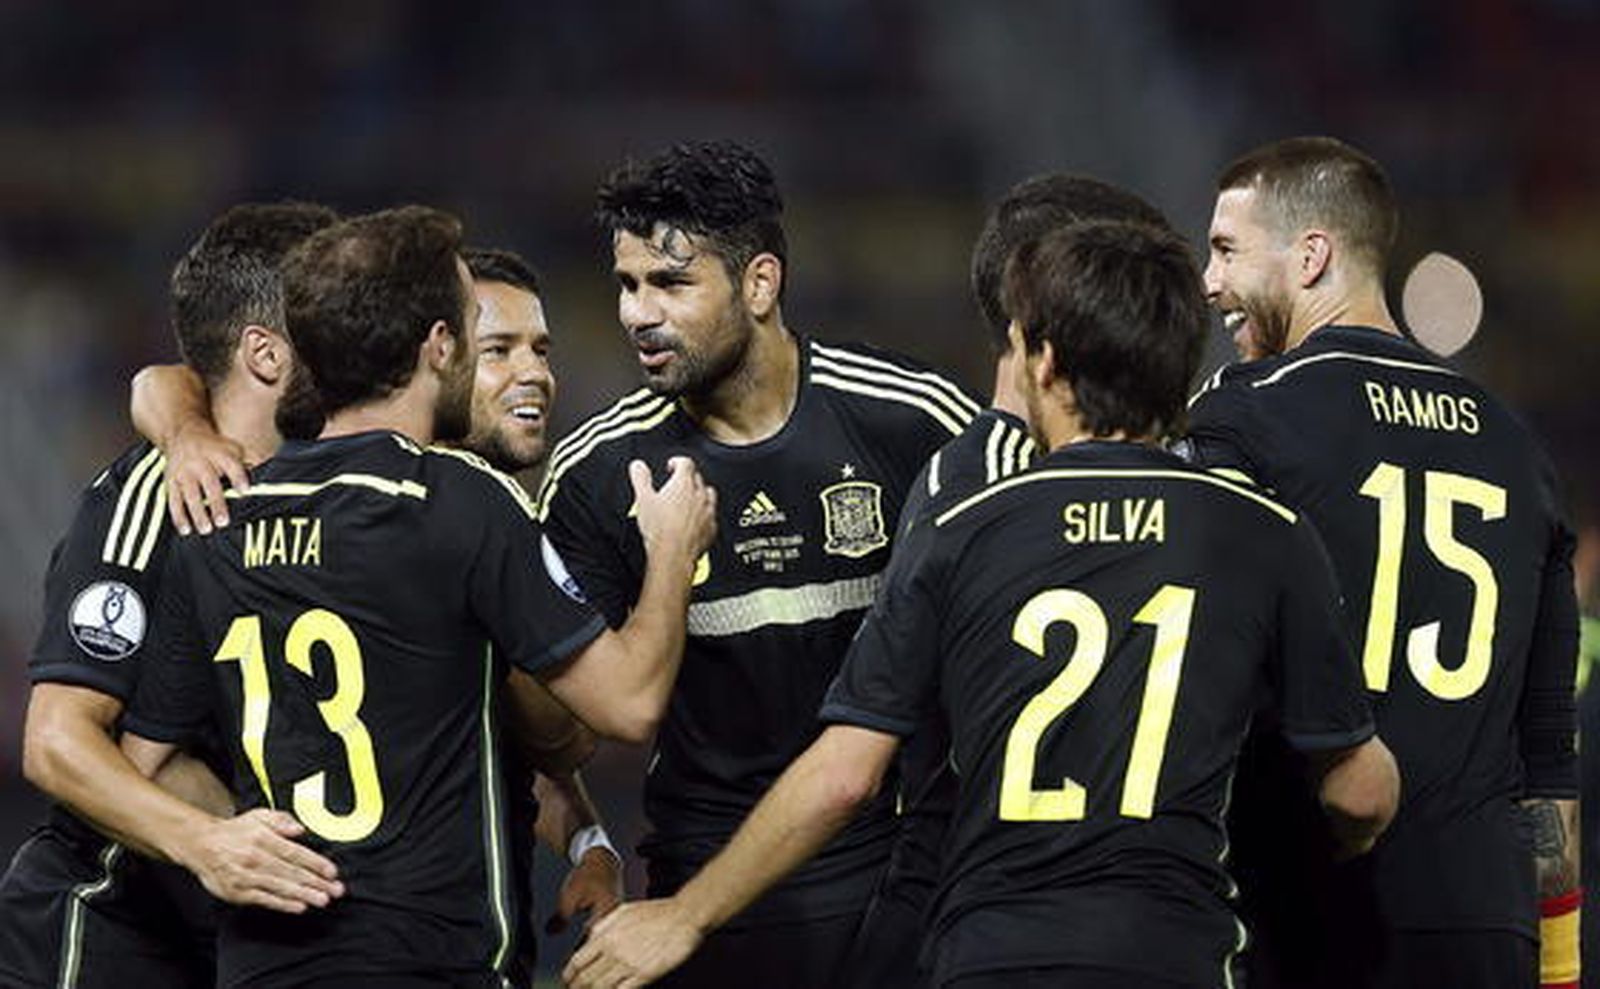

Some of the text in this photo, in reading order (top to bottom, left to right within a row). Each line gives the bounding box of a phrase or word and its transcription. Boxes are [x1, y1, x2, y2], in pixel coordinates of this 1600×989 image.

[1365, 381, 1480, 434] RAMOS
[244, 517, 322, 569] MATA
[1064, 498, 1166, 545] SILVA
[1358, 461, 1508, 701] 15
[213, 608, 384, 843] 13
[1000, 585, 1197, 822] 21
